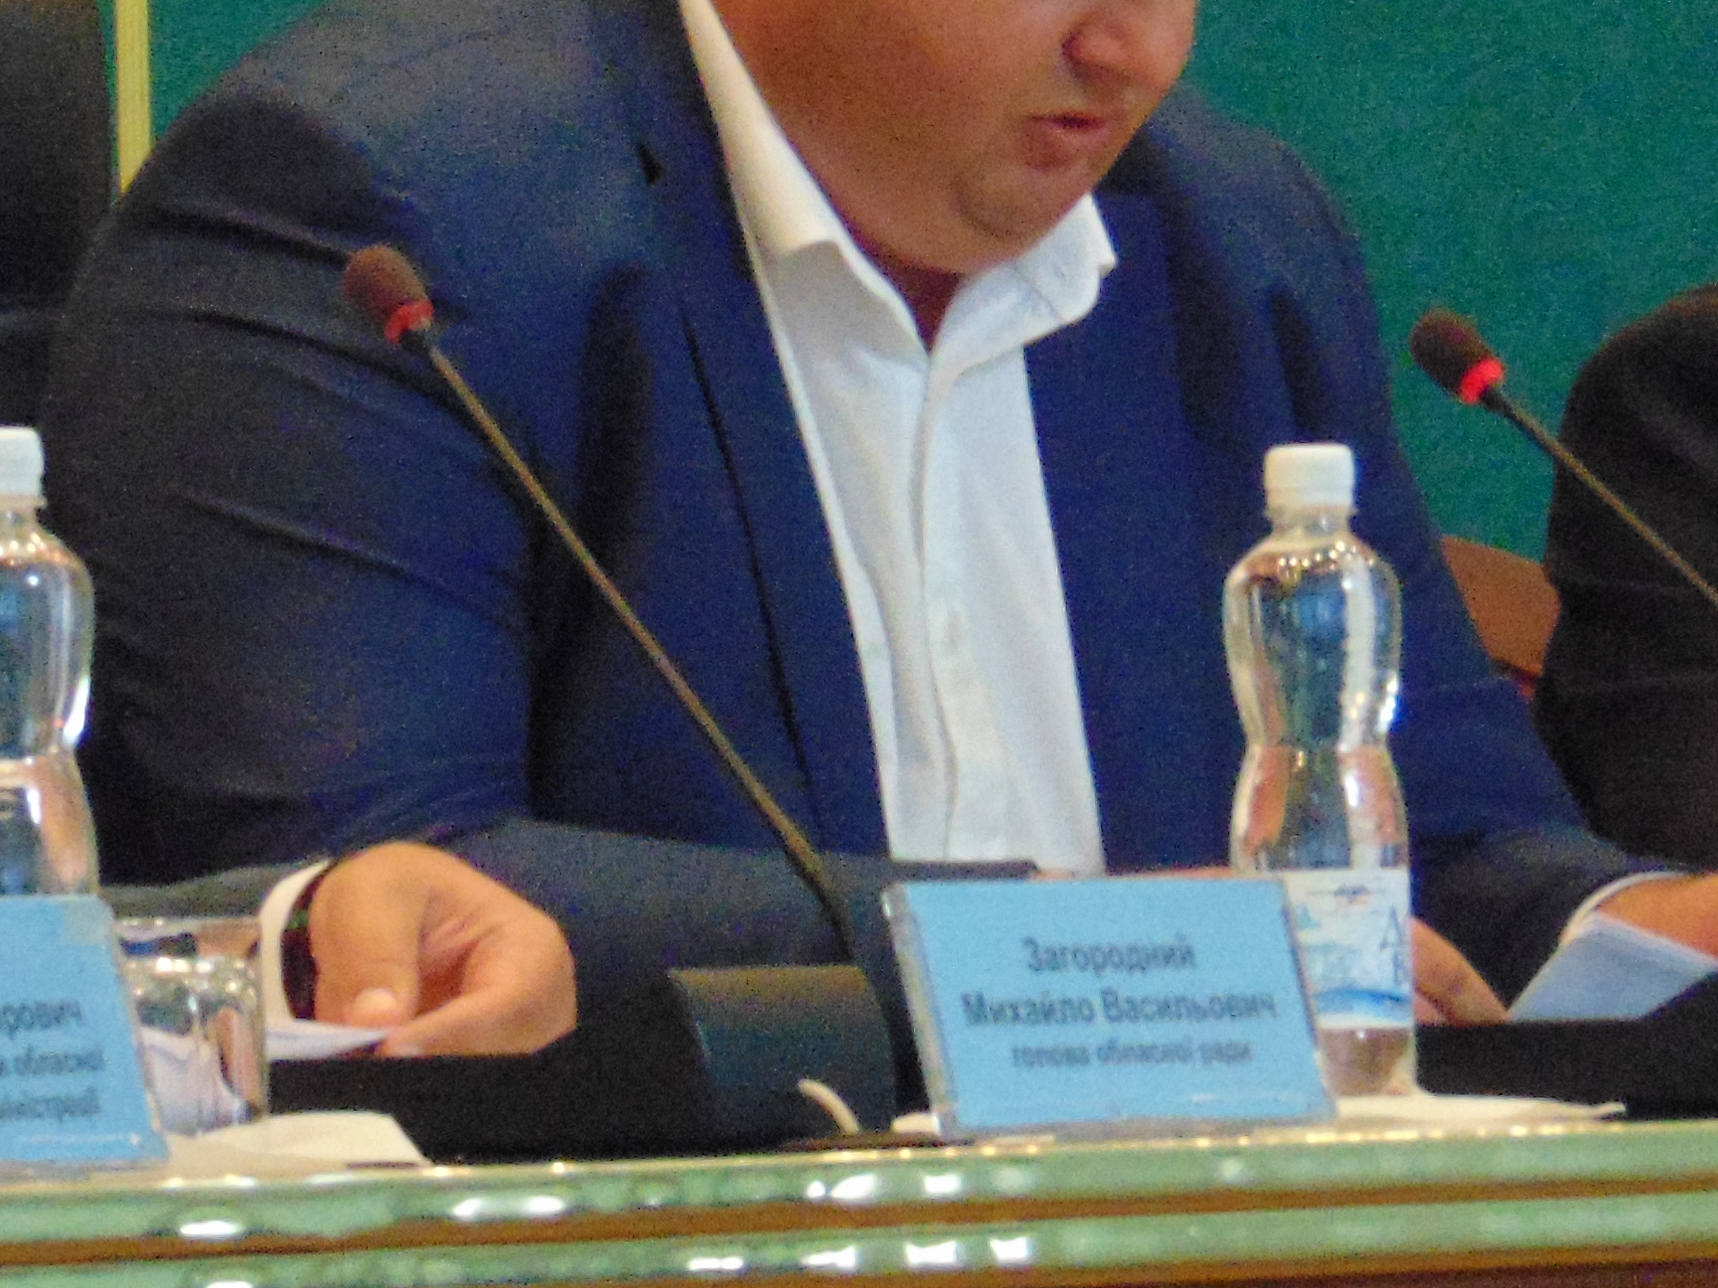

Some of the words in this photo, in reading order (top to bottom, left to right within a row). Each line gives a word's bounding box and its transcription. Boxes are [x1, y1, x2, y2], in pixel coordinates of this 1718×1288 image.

[961, 990, 1097, 1028] Михайло
[1100, 987, 1278, 1024] Васильович
[1012, 1043, 1091, 1069] голова
[1095, 1036, 1193, 1066] обласної
[1197, 1042, 1253, 1066] ради
